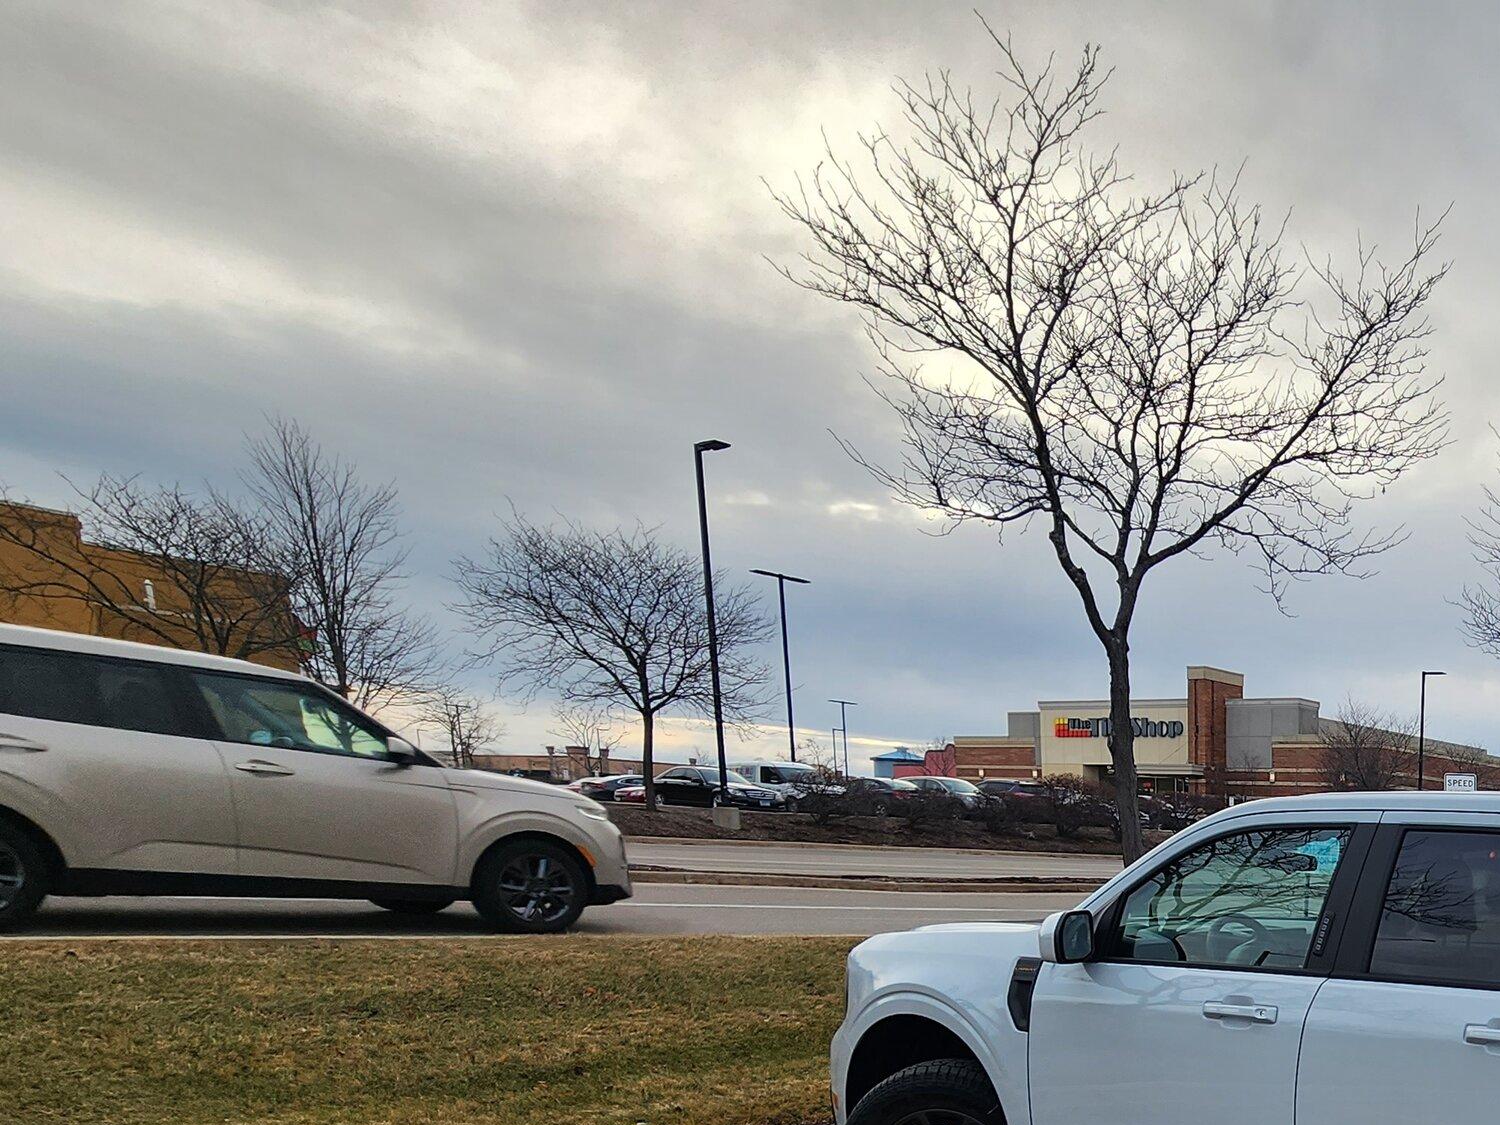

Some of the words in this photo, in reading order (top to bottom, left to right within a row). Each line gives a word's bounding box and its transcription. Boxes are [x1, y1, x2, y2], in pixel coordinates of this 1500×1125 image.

[1068, 718, 1091, 730] The
[1131, 717, 1184, 739] Shop
[1447, 779, 1474, 788] SPEED
